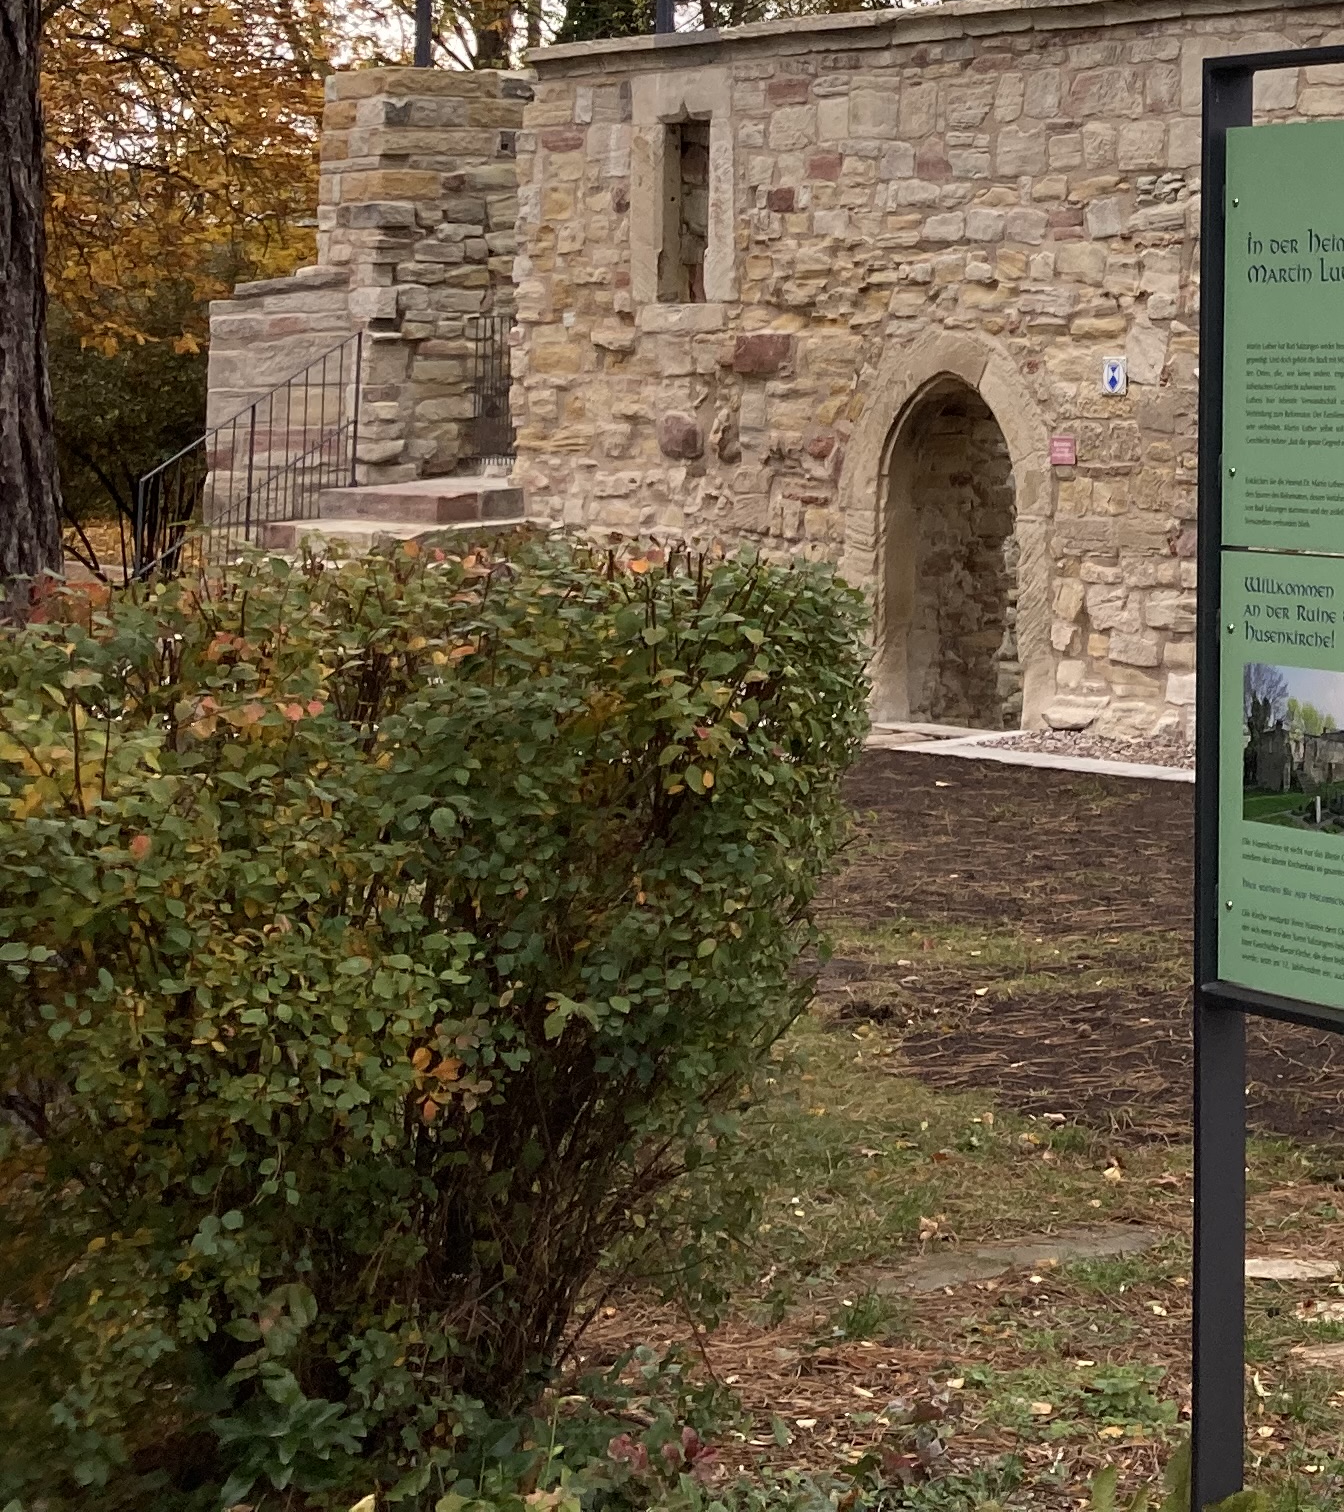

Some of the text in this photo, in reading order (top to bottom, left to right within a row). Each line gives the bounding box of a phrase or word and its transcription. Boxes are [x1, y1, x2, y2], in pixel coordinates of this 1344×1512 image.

[1247, 231, 1263, 254] In
[1269, 239, 1298, 254] der
[1247, 264, 1312, 284] Martin
[1244, 576, 1334, 598] Willkommen
[1243, 604, 1261, 617] an
[1265, 604, 1290, 620] der
[1296, 604, 1336, 624] Ruine
[1244, 620, 1334, 648] Husenkirche!
